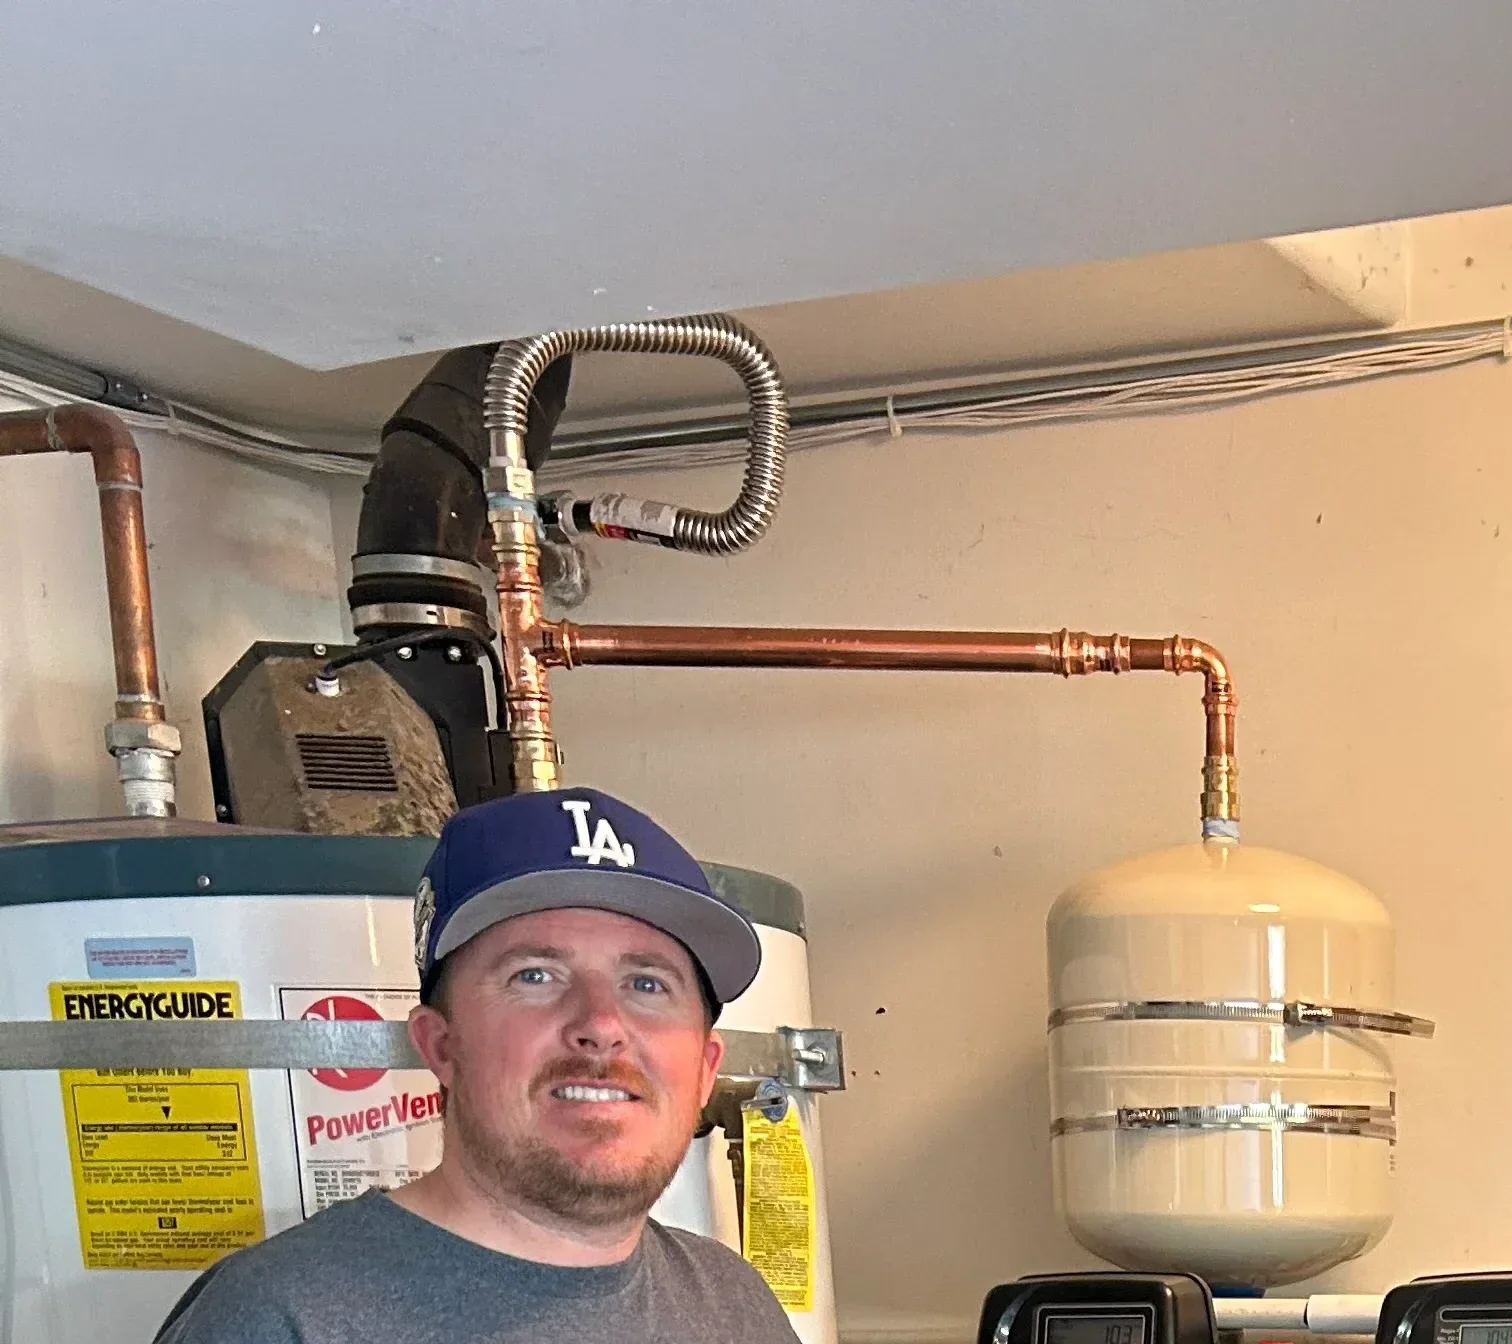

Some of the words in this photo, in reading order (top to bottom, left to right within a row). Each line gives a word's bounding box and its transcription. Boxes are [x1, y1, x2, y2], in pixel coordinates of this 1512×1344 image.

[562, 800, 635, 868] LA
[64, 992, 234, 1020] ENERGYGUIDE
[307, 1091, 442, 1146] PowerVen
